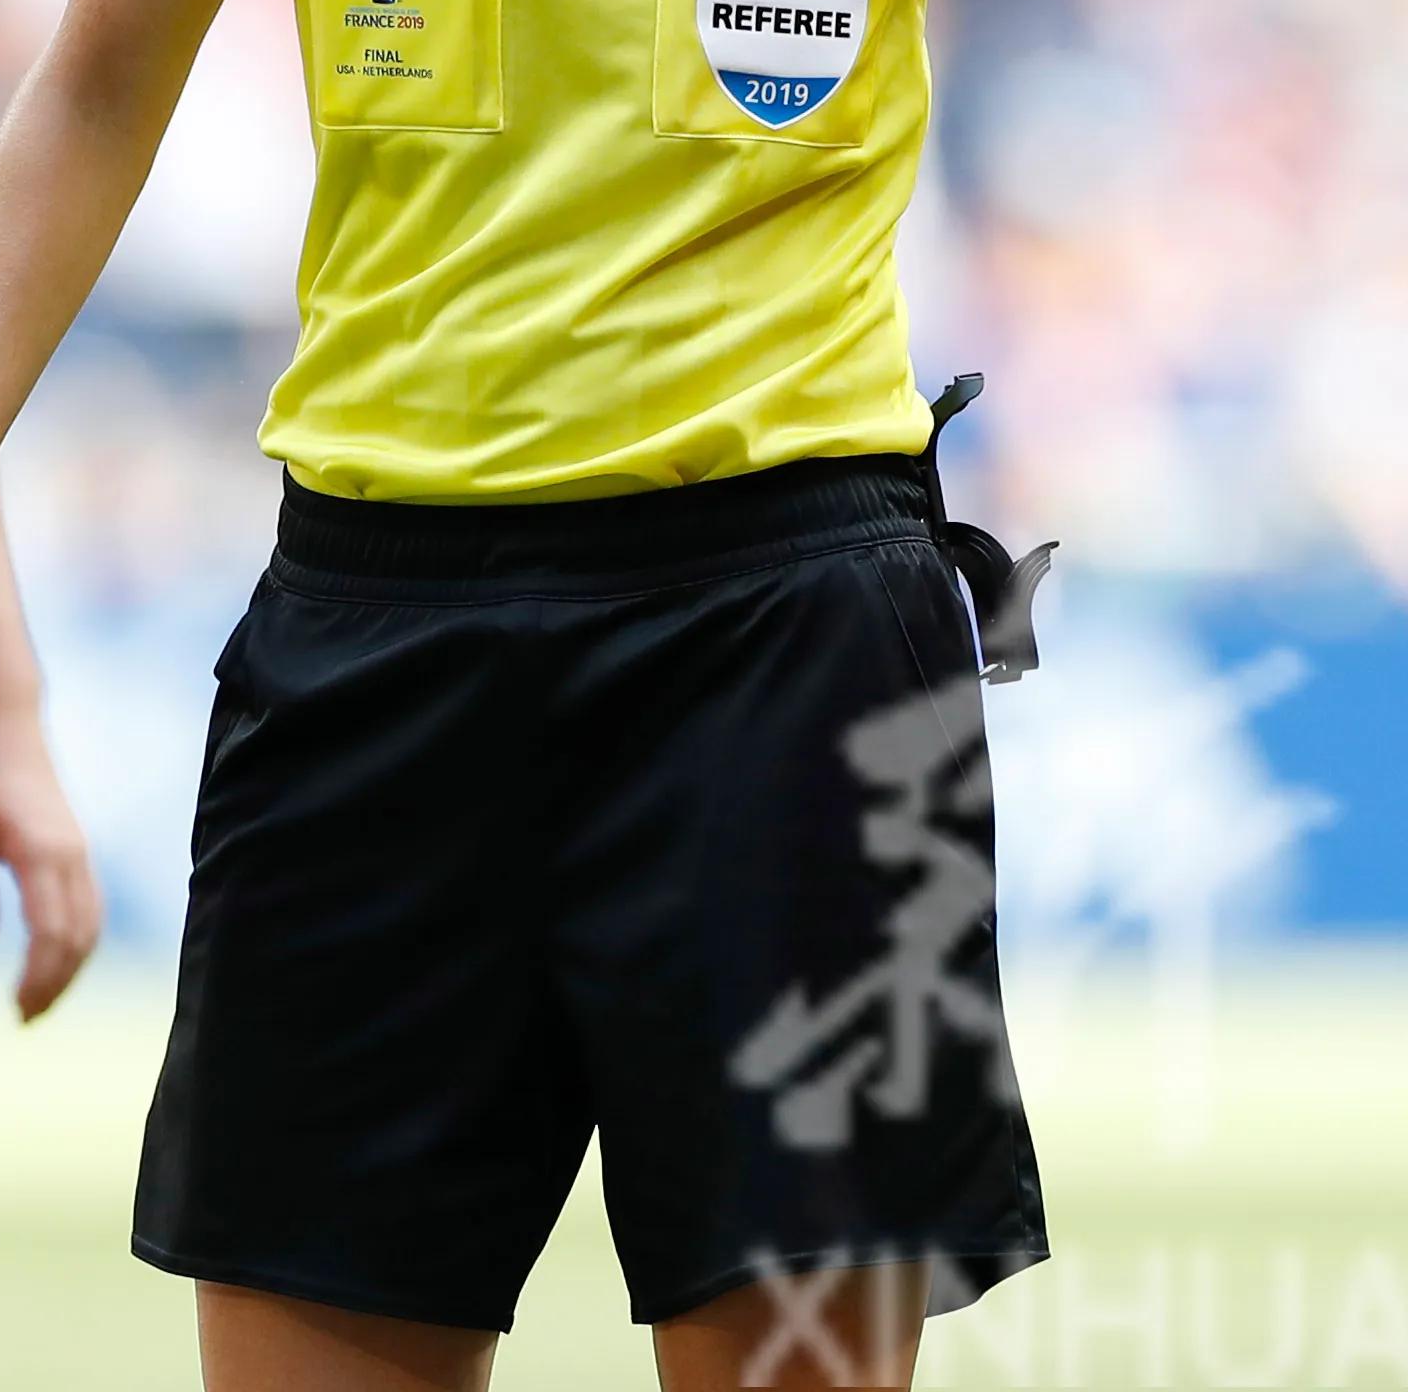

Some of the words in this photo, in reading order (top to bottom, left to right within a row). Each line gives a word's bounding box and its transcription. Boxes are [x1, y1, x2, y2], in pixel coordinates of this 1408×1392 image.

[345, 13, 395, 28] FRANCE
[397, 15, 425, 29] 2019
[712, 2, 852, 38] REFEREE
[364, 49, 404, 63] FINAL
[336, 64, 355, 74] USA
[363, 66, 433, 79] NETHERLANDS
[744, 80, 809, 106] 2019
